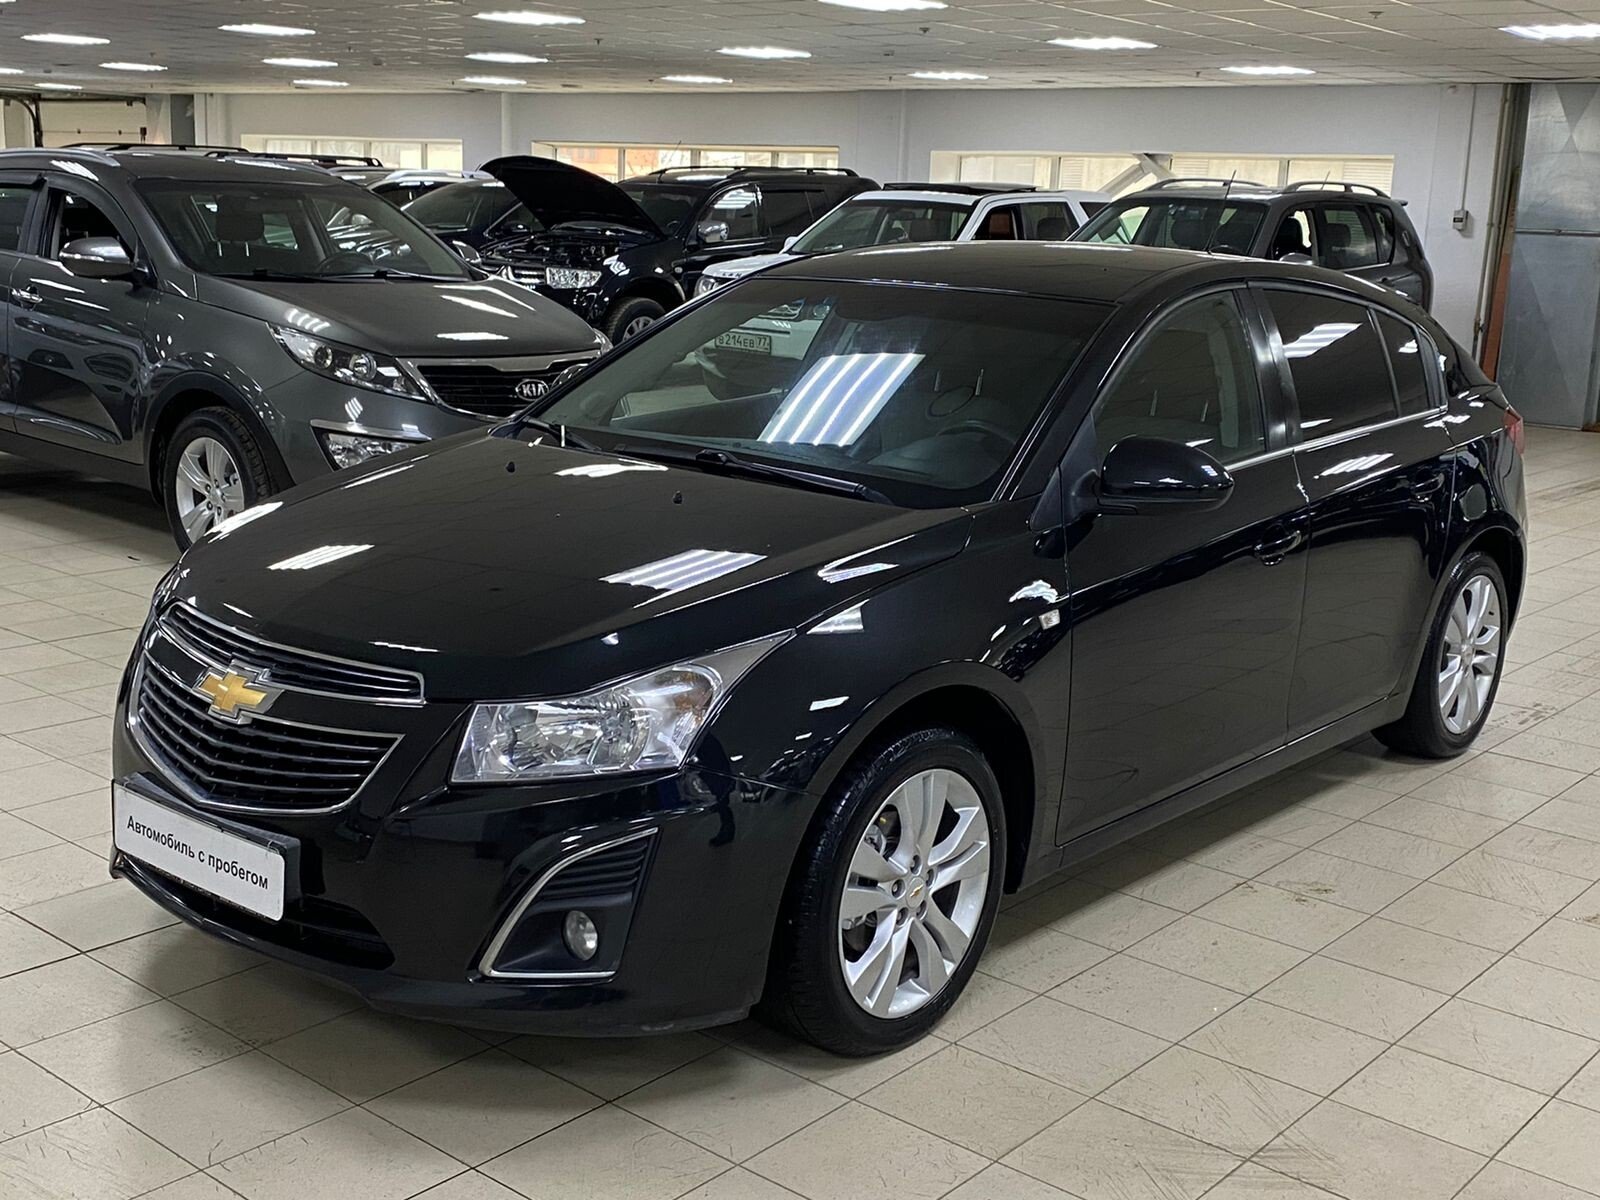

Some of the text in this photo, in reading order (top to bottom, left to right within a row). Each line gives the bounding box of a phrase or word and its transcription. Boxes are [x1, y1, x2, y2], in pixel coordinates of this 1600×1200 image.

[522, 384, 546, 396] KIA
[127, 815, 268, 890] Автомобиль с пробегом
